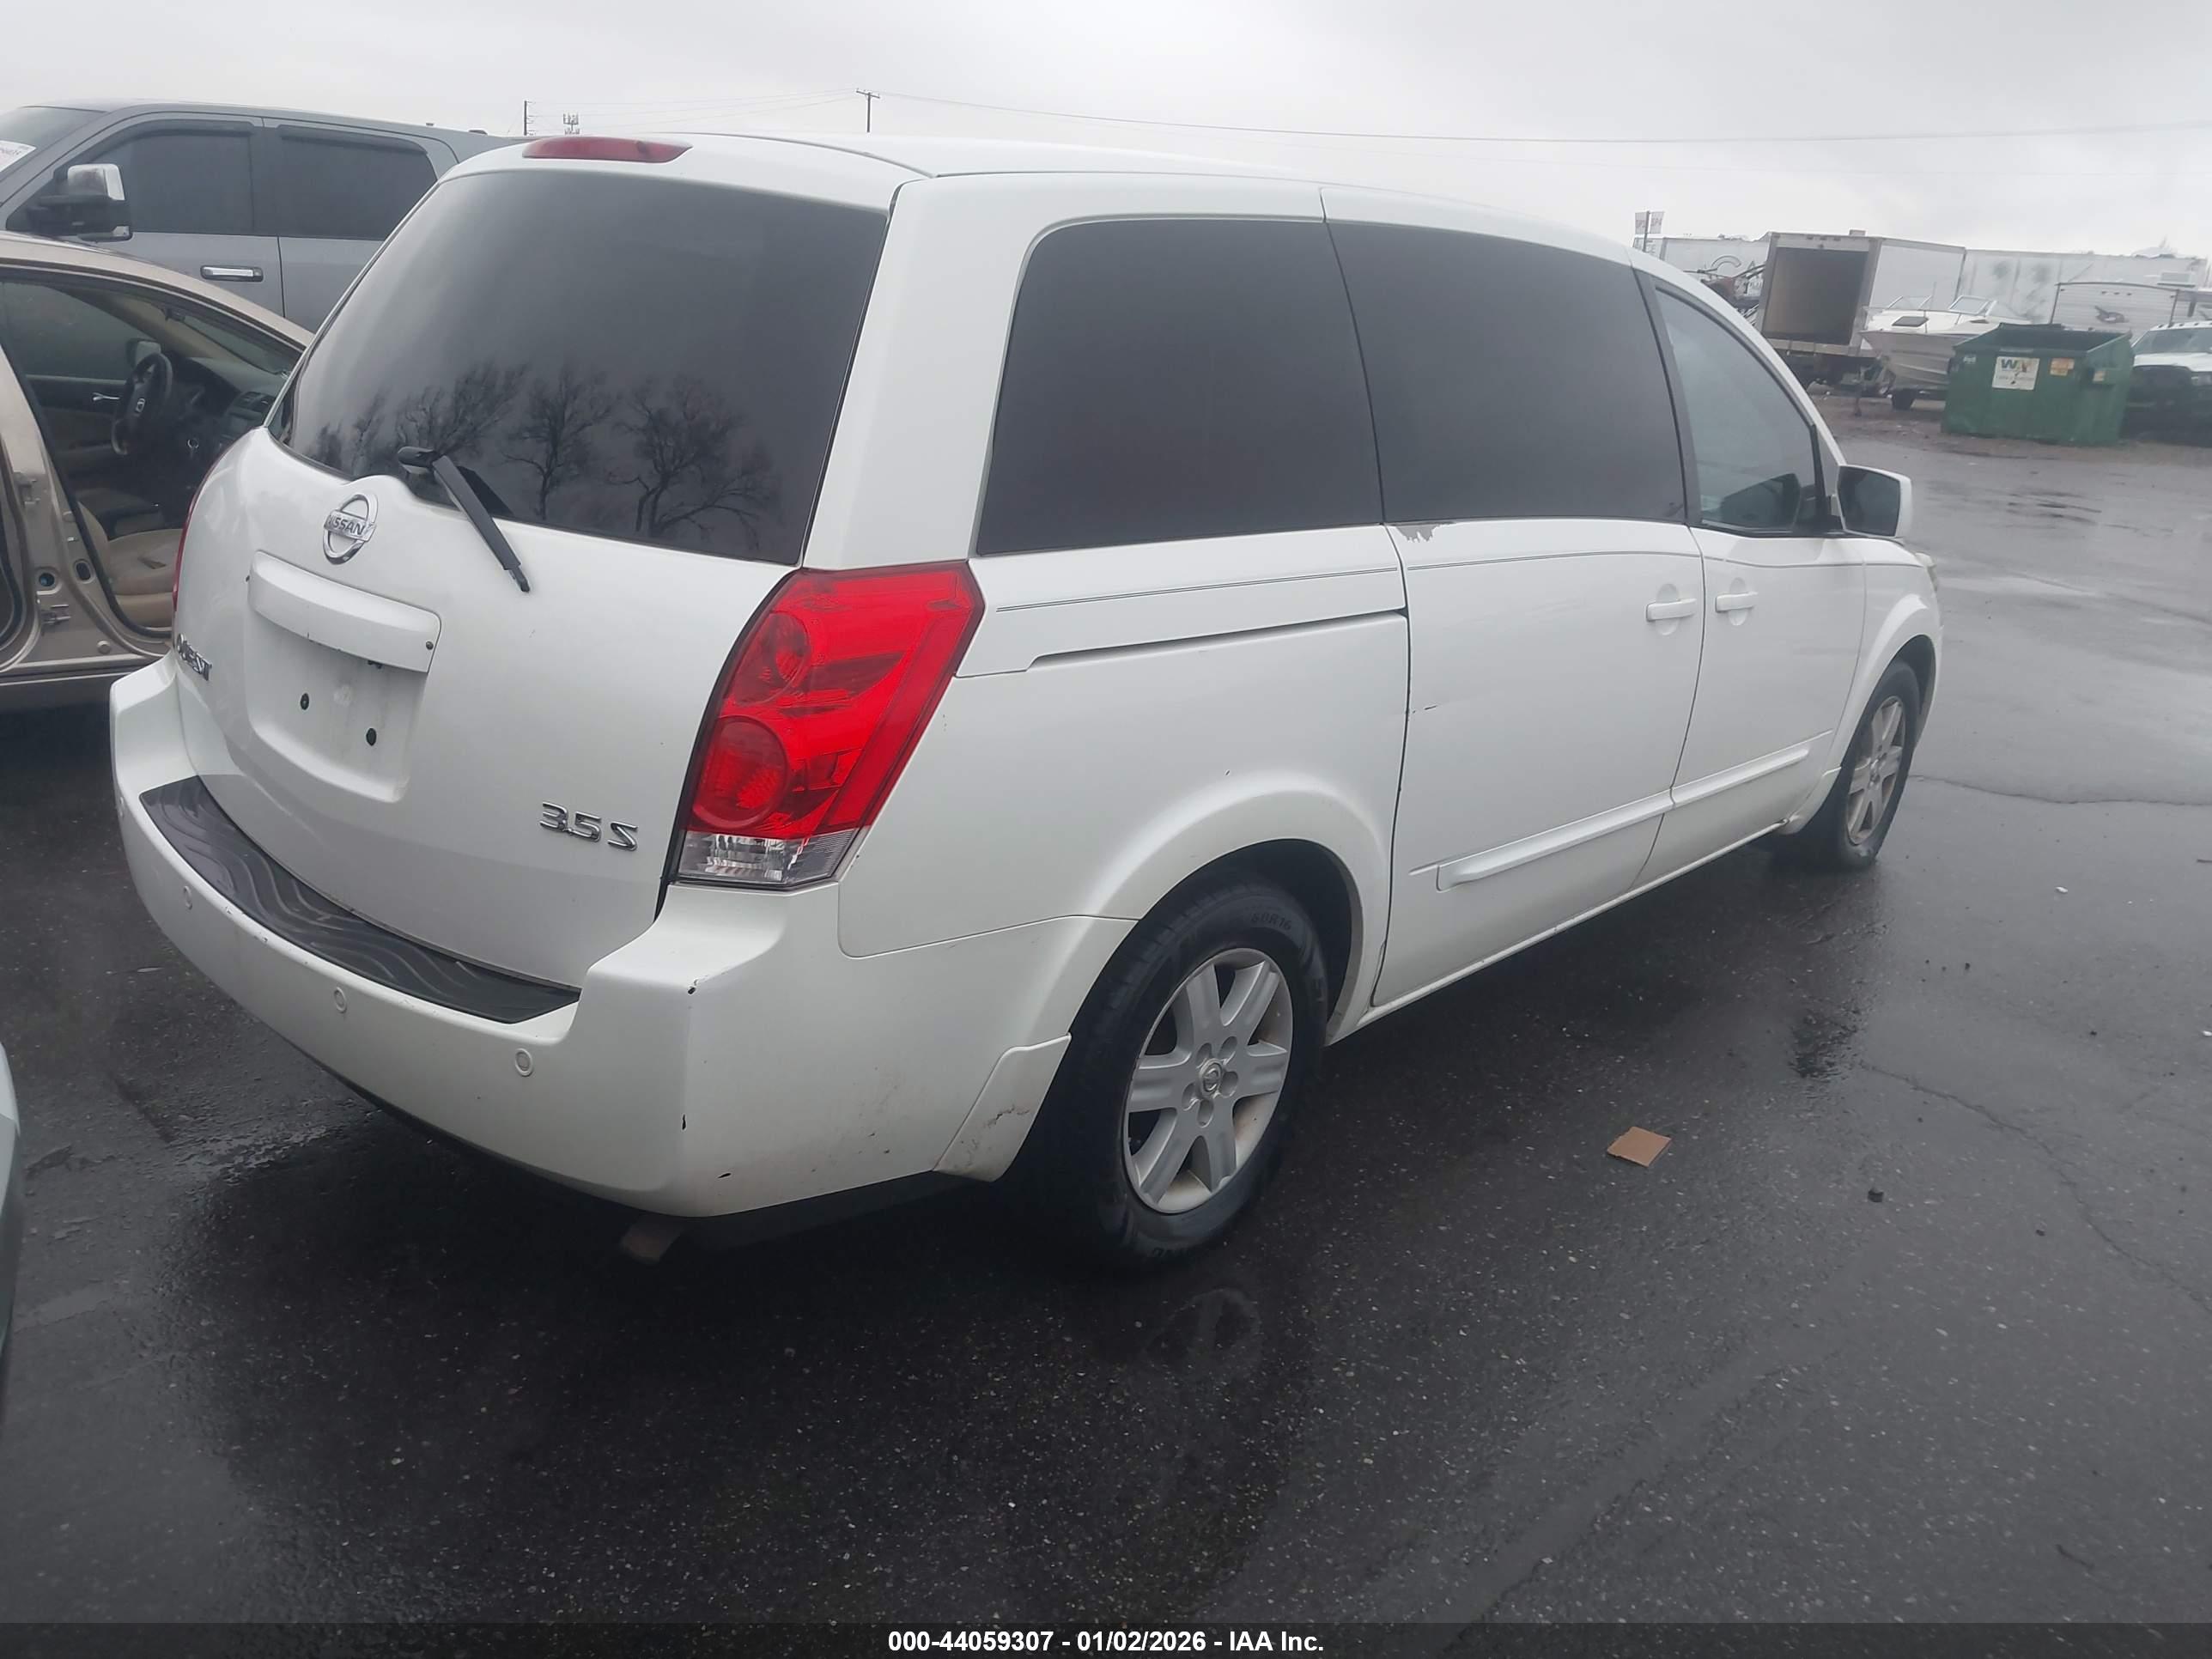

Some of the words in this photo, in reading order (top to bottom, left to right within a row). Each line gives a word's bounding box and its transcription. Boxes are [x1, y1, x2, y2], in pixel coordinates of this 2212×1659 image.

[327, 514, 367, 536] NISSAN
[539, 800, 602, 842] 3.5
[606, 820, 639, 852] S
